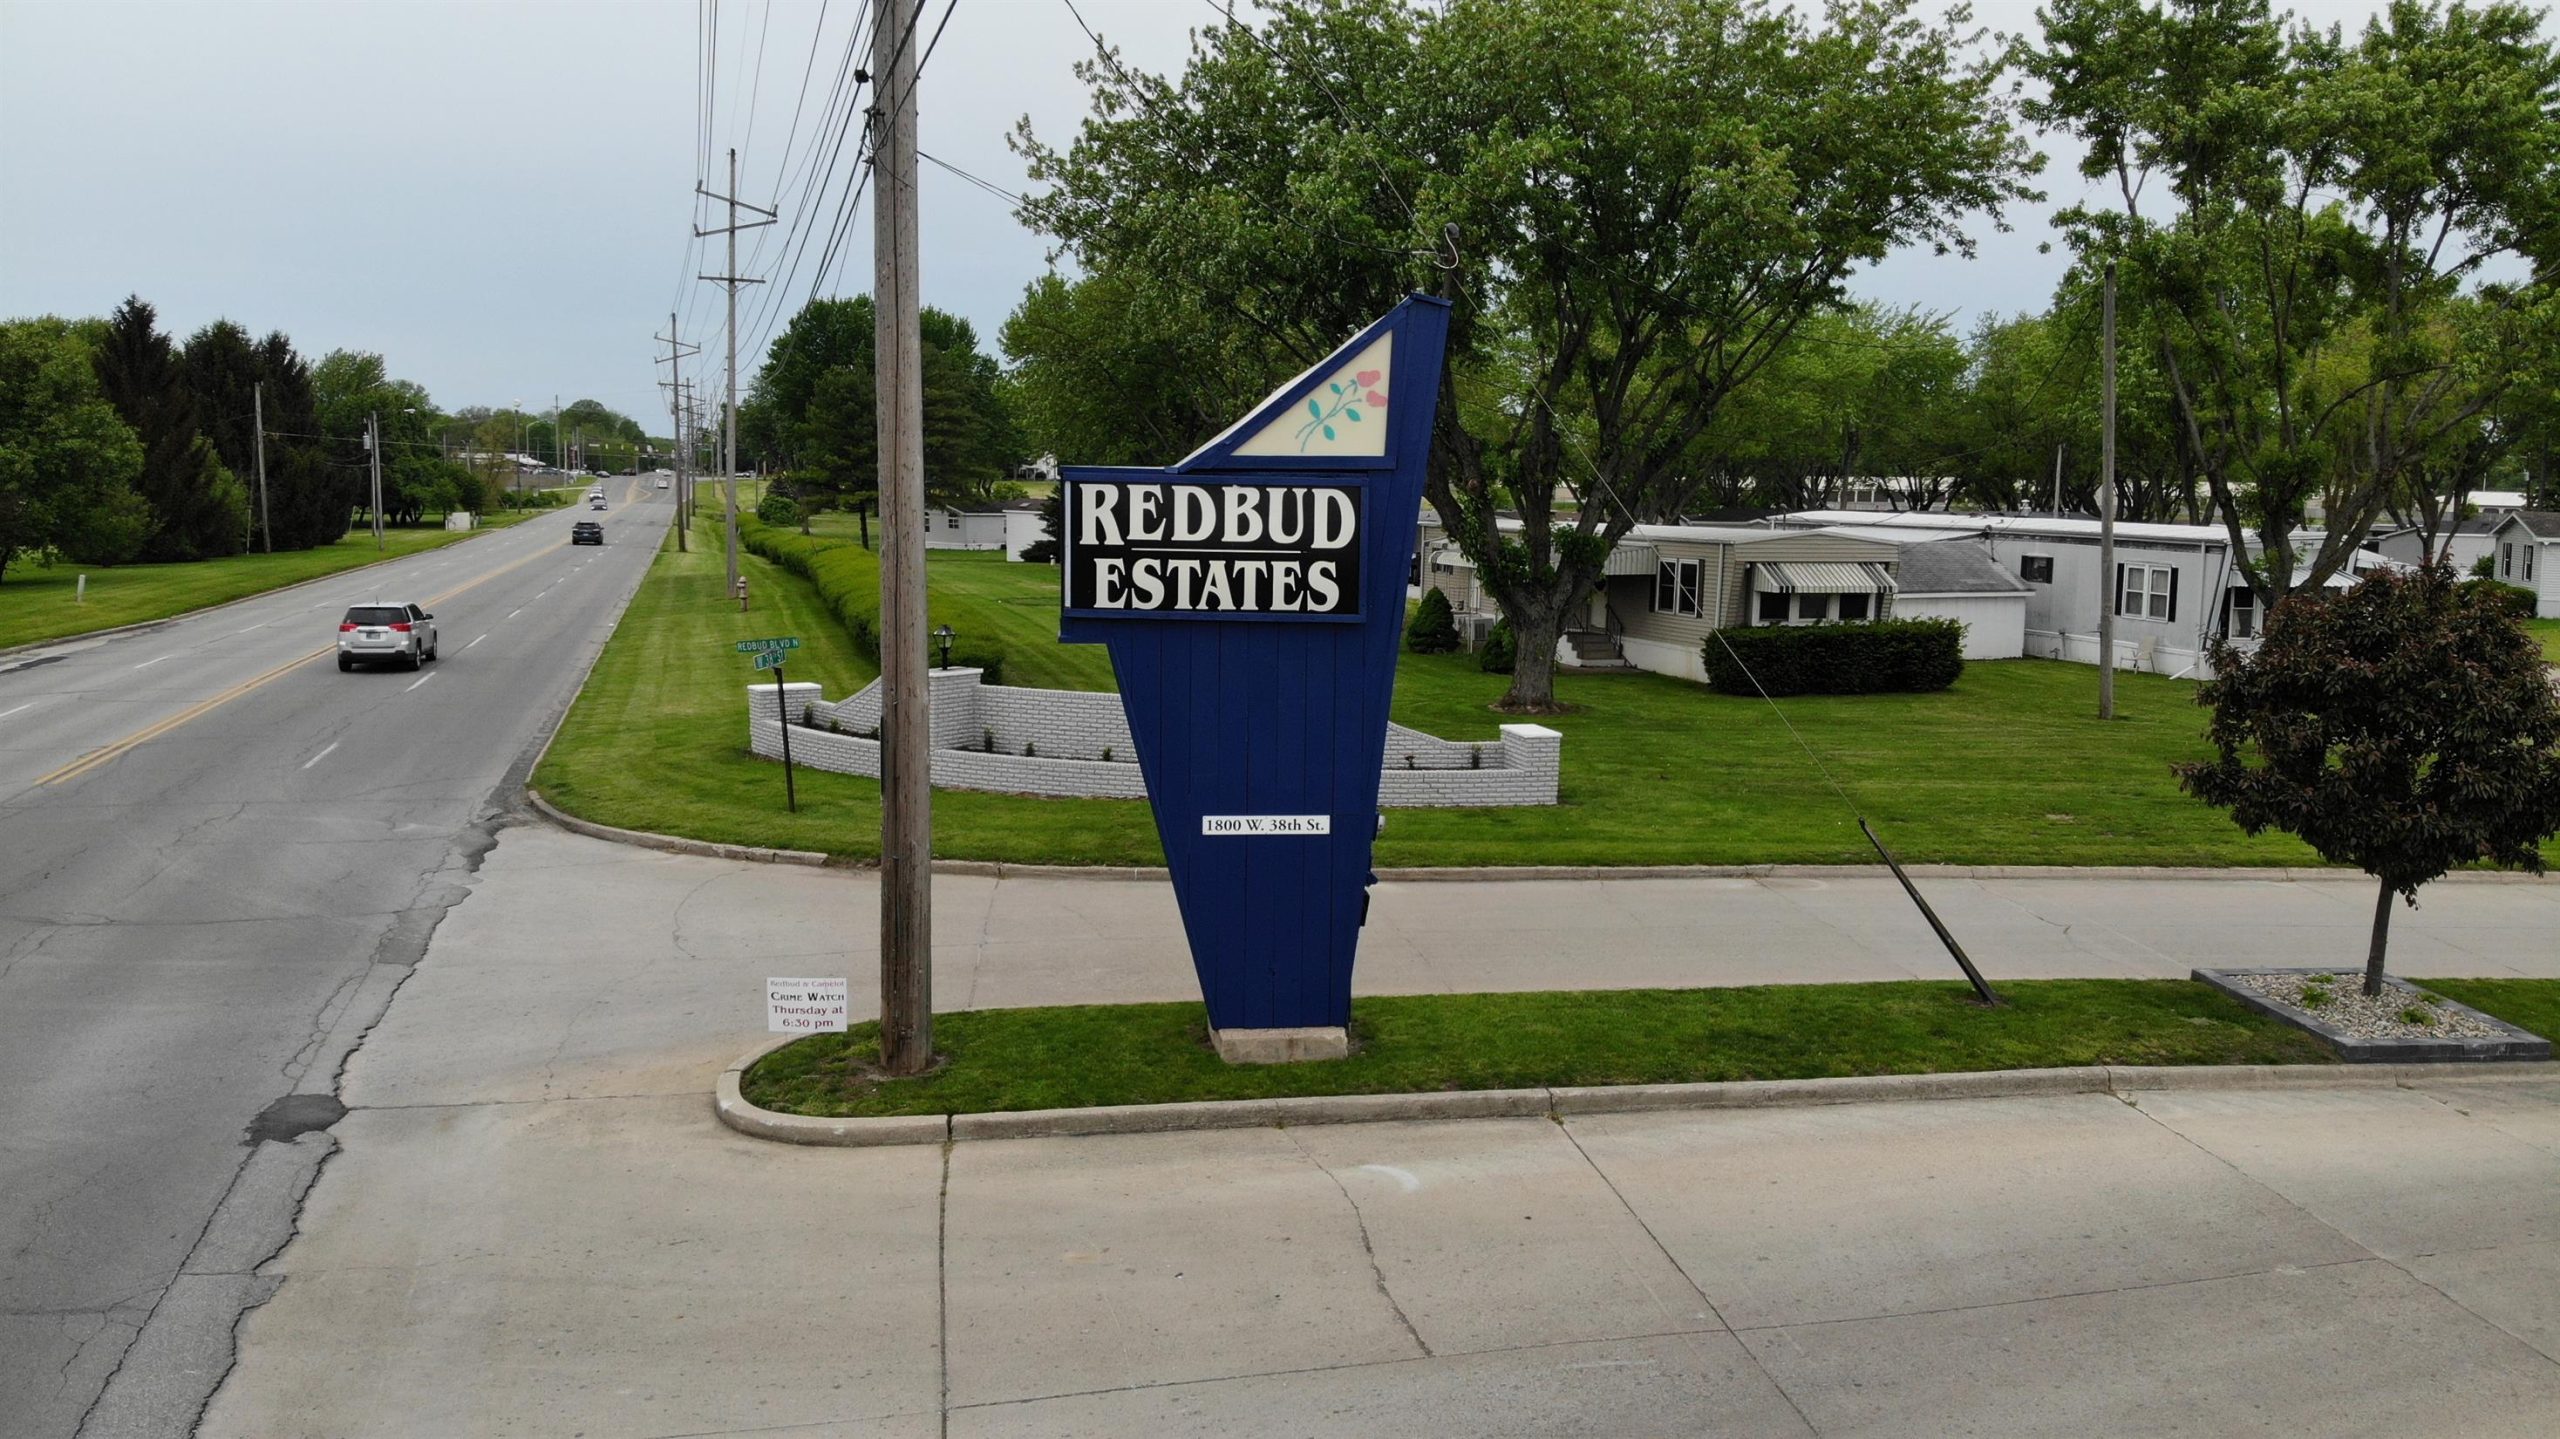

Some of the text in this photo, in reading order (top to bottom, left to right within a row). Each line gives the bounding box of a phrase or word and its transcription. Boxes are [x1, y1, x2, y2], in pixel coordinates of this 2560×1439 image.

[1079, 484, 1356, 549] REDBUD
[1094, 557, 1340, 612] ESTATES
[737, 641, 768, 651] REDBUD
[769, 639, 790, 649] BLVD
[1207, 818, 1325, 831] 1800 W. 38th St.
[772, 1004, 844, 1016] Thursday at
[782, 1018, 834, 1029] 6:30 pm
